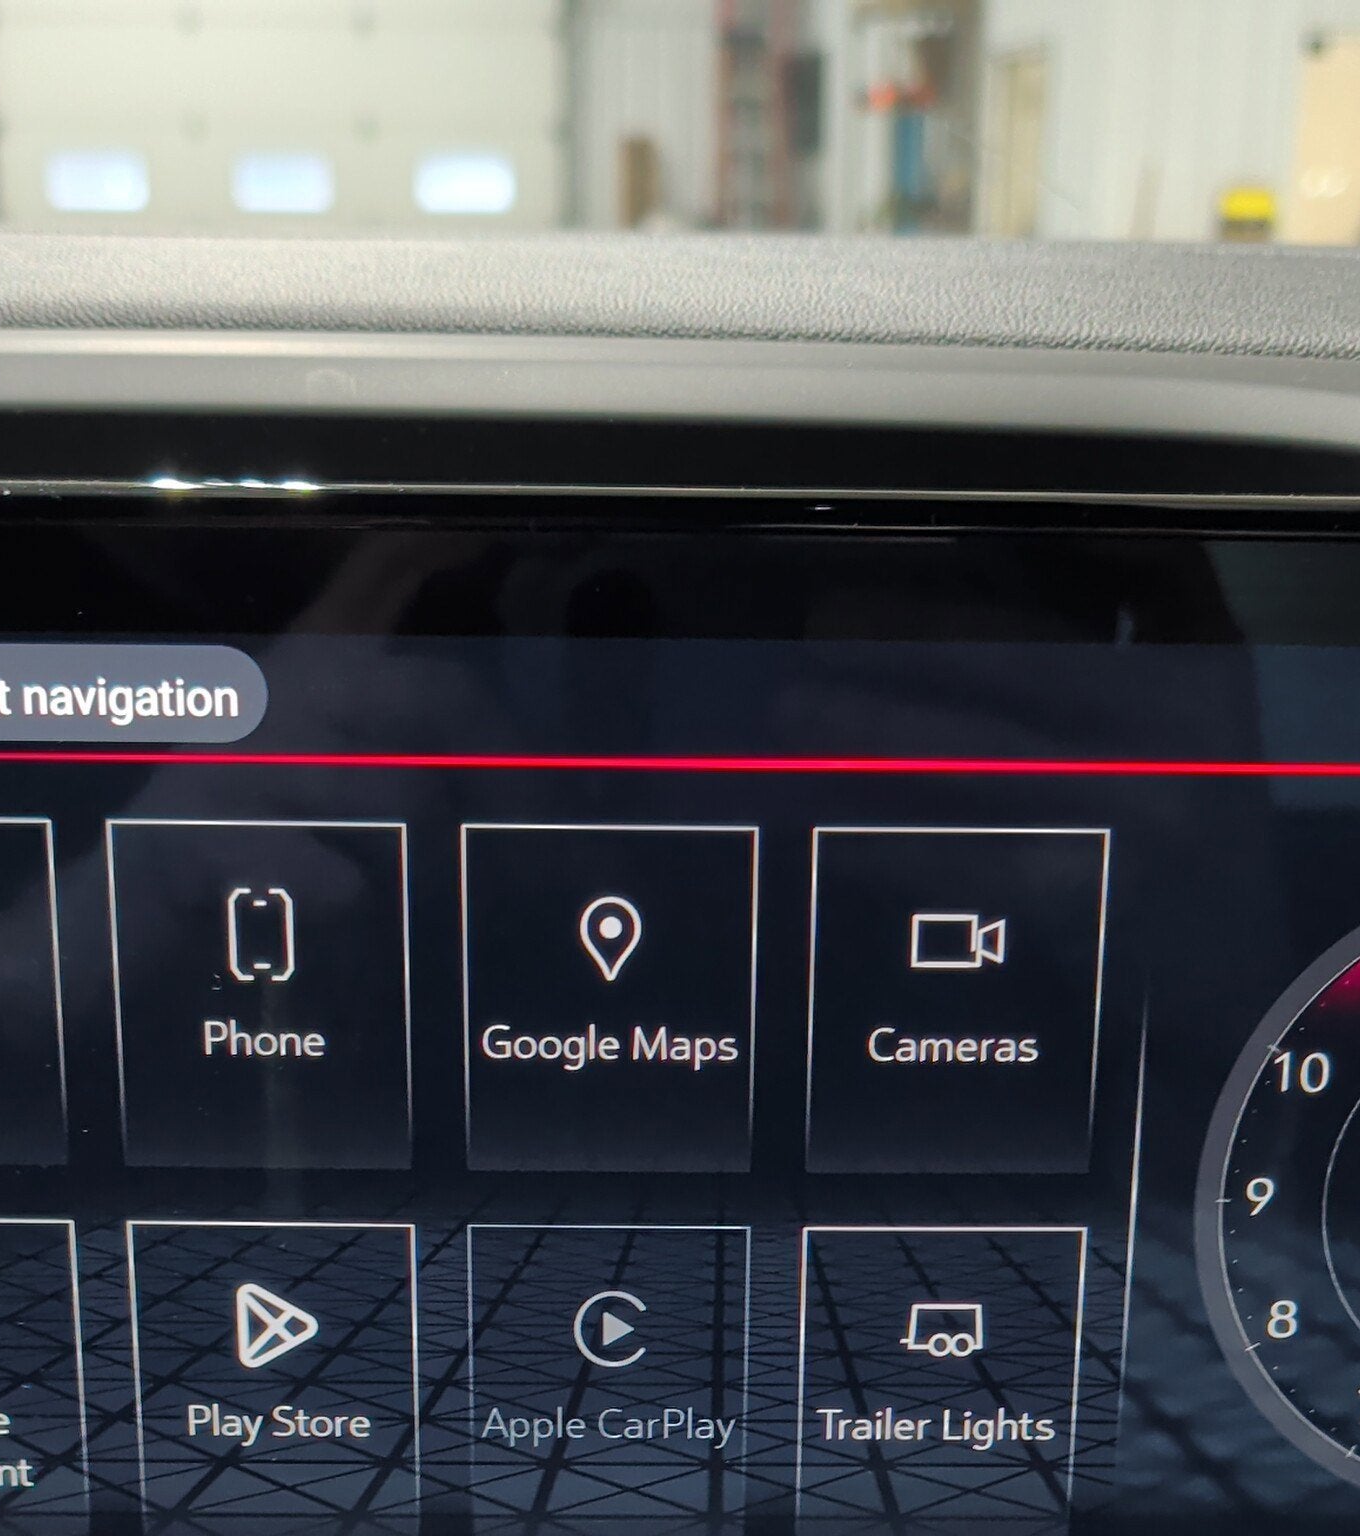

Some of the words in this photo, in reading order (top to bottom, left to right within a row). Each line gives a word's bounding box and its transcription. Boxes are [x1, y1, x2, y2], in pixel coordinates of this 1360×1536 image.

[23, 677, 240, 727] navigation
[203, 1019, 326, 1058] Phone
[482, 1024, 621, 1071] Google
[632, 1026, 739, 1071] Maps
[868, 1027, 1039, 1063] Cameras
[1273, 1051, 1331, 1093] 10
[1246, 1177, 1275, 1216] 9
[1267, 1299, 1298, 1339] 8
[188, 1404, 264, 1447] Play
[272, 1405, 371, 1438] Store
[481, 1406, 587, 1448] Apple
[598, 1407, 736, 1449] CarPlay
[817, 1408, 932, 1442] Trailer
[942, 1408, 1056, 1451] Lights
